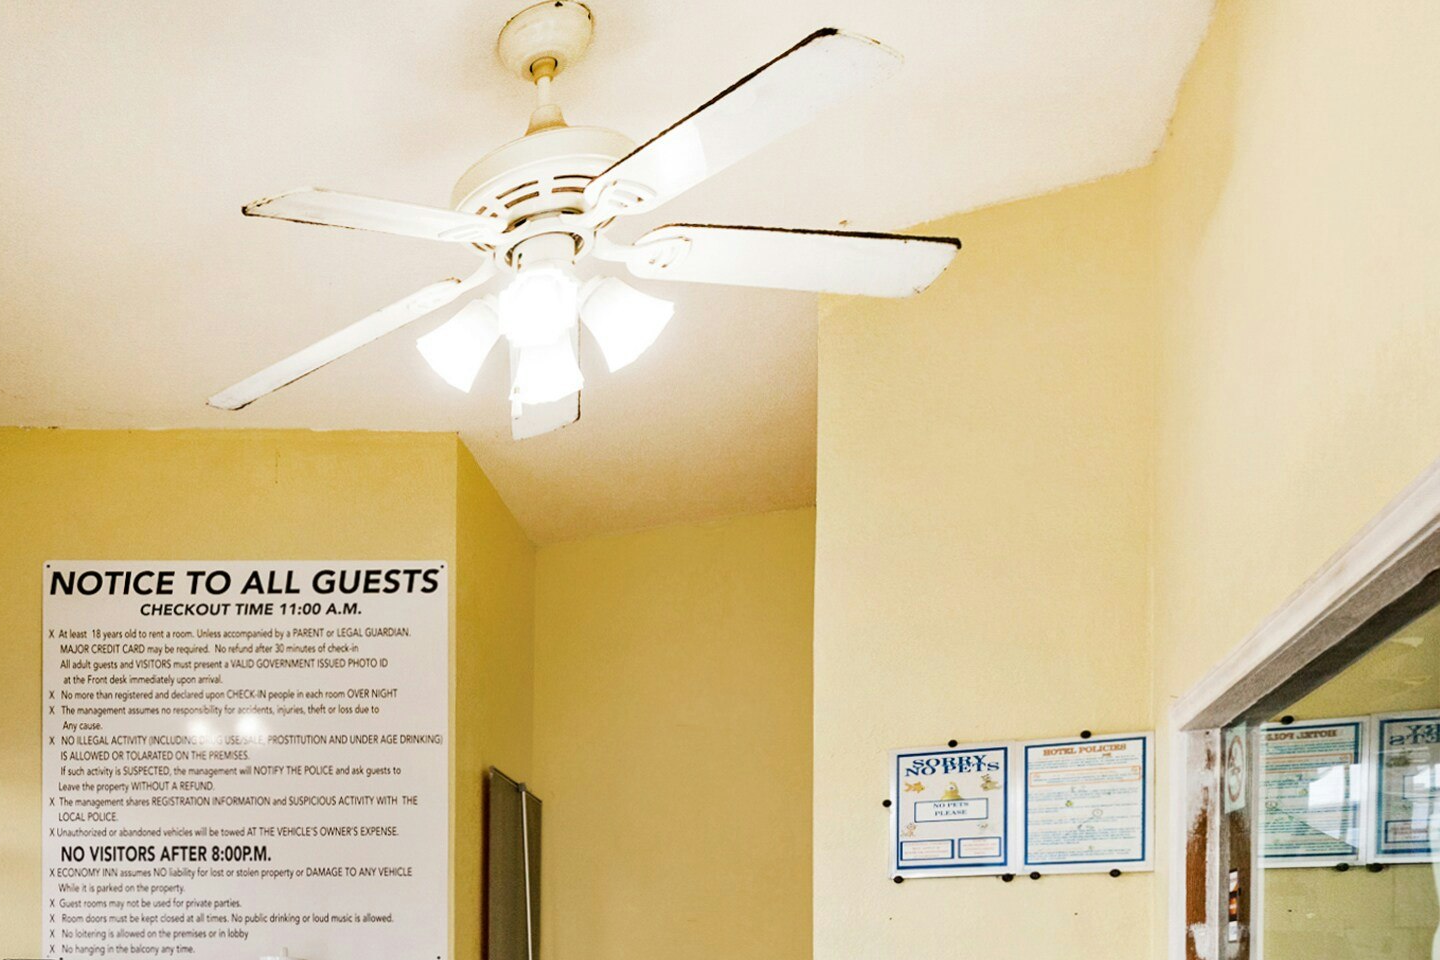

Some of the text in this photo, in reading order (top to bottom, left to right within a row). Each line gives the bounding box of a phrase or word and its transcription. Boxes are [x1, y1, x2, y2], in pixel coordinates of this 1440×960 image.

[50, 569, 439, 595] NOTICE TO ALL GUESTS
[140, 602, 362, 616] CHECKOUT TIME 11:00 A.M.
[49, 627, 411, 642] X At least 18 years old to rent a room. Unless accompanied by a PARENT or LEGAL GUARDIAN.
[60, 643, 359, 657] MAJOR CREDIT CARD may be required. No refund after 30 minutes of check-in
[60, 658, 388, 672] All adult guests and VISITORS must present a VALID GOVERNMENT ISSUED PHOTO ID
[63, 674, 223, 688] at the Front desk immediately upon arrival.
[49, 689, 397, 703] X No more than registered and declared upon CHECK-IN people in each room OVER NIGHT
[62, 721, 78, 734] Any
[49, 735, 55, 746] X
[61, 735, 75, 746] NO
[76, 735, 109, 746] ILLEGAL
[111, 735, 147, 745] ACTIVITY
[268, 735, 327, 745] PROSTITUTION
[328, 735, 348, 745] AND
[349, 735, 379, 745] UNDER
[380, 734, 398, 745] AGE
[400, 734, 443, 746] DRINKING)
[60, 751, 68, 761] IS
[69, 750, 110, 761] ALLOWED
[112, 750, 124, 761] OR
[126, 750, 174, 761] TOLARATED
[175, 750, 189, 761] ON
[191, 750, 207, 761] THE
[1043, 744, 1126, 756] HOTEL POLICIES
[913, 755, 987, 767] SORRY
[905, 762, 1000, 777] NO PETS
[49, 796, 418, 810] X The management shares REGISTRATION INFORMATION and SUSPICIOUS ACTIVITY WITH THE
[58, 812, 119, 822] LOCAL POLICE.
[49, 827, 399, 838] X Unauthorized or abandoned vehicles will be towed AT THE VEHICLE'S OWNER'S EXPENSE.
[61, 846, 272, 862] NO VISITORS AFTER 8:00P.M.
[50, 944, 196, 957] X No hanging in the balcony any time.
